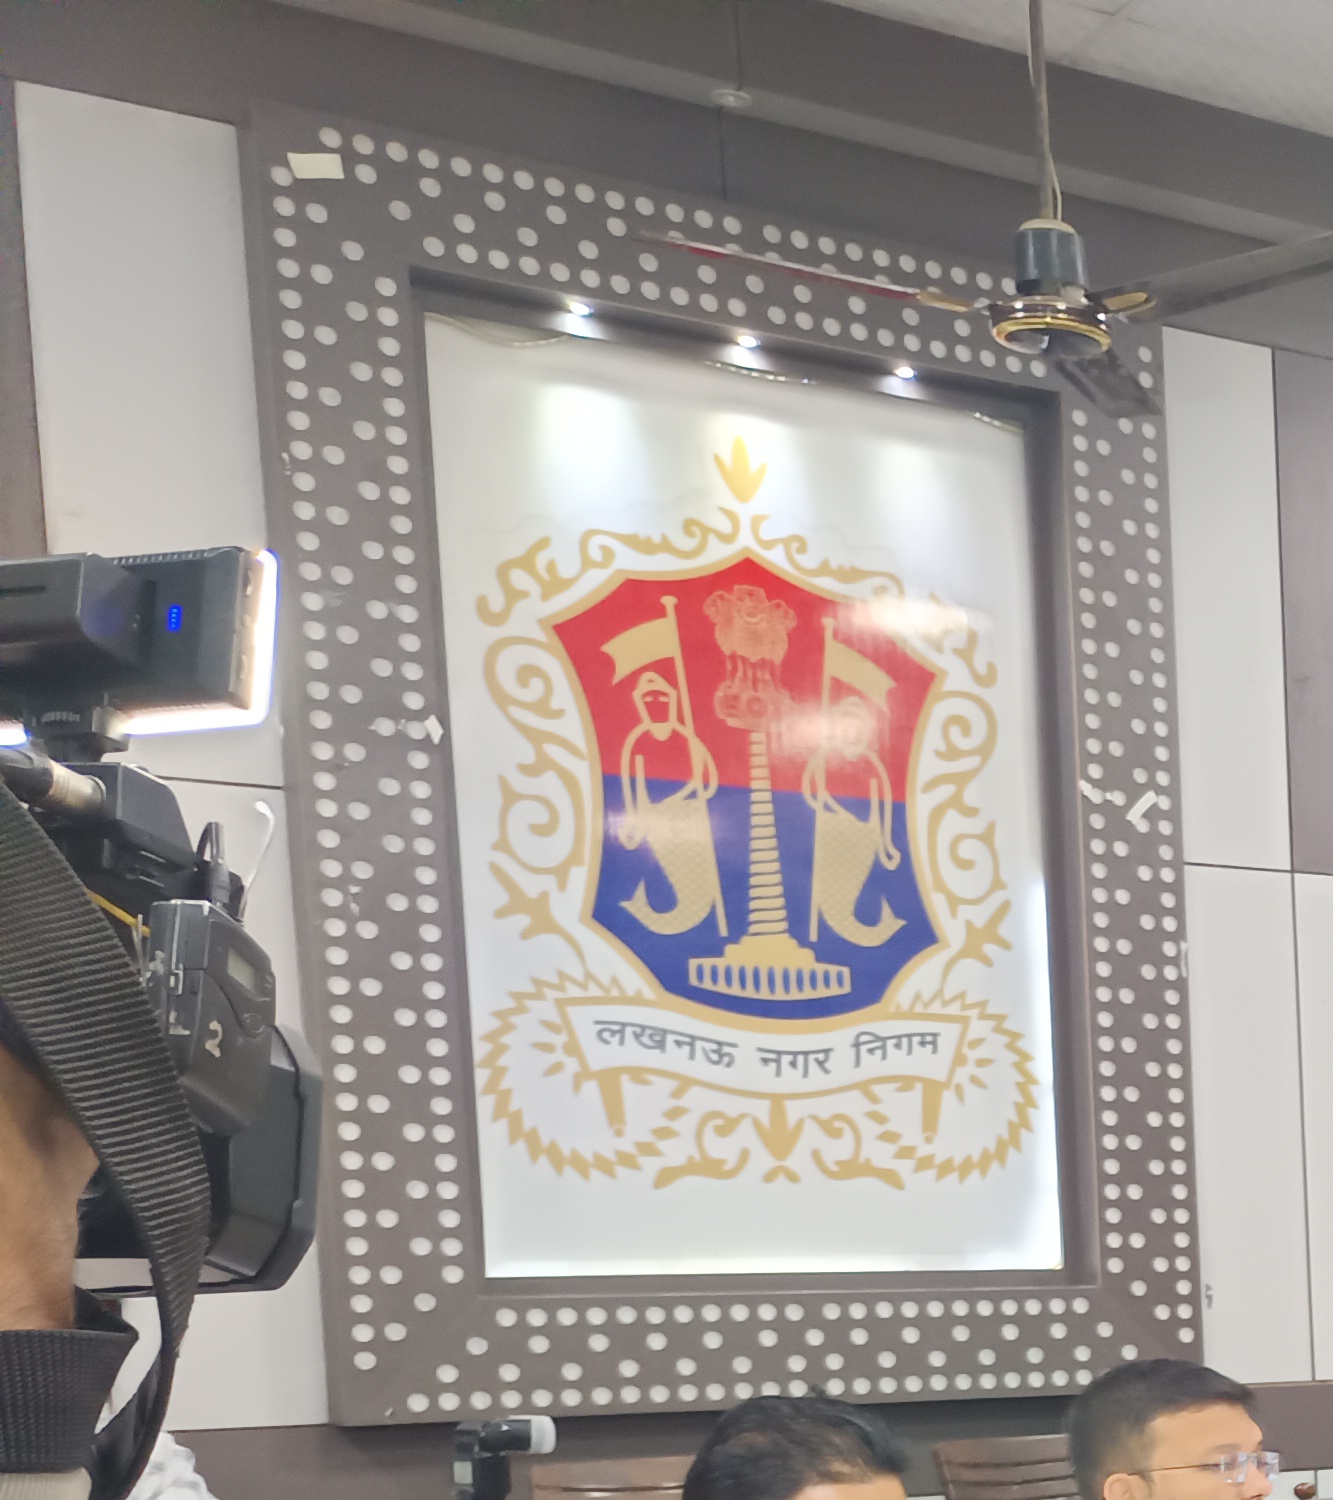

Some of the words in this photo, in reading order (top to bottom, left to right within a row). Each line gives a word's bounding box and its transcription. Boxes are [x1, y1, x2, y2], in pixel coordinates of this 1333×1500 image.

[594, 1020, 739, 1069] लखनऊ
[756, 1046, 835, 1078] नगर
[851, 1031, 941, 1068] निगम
